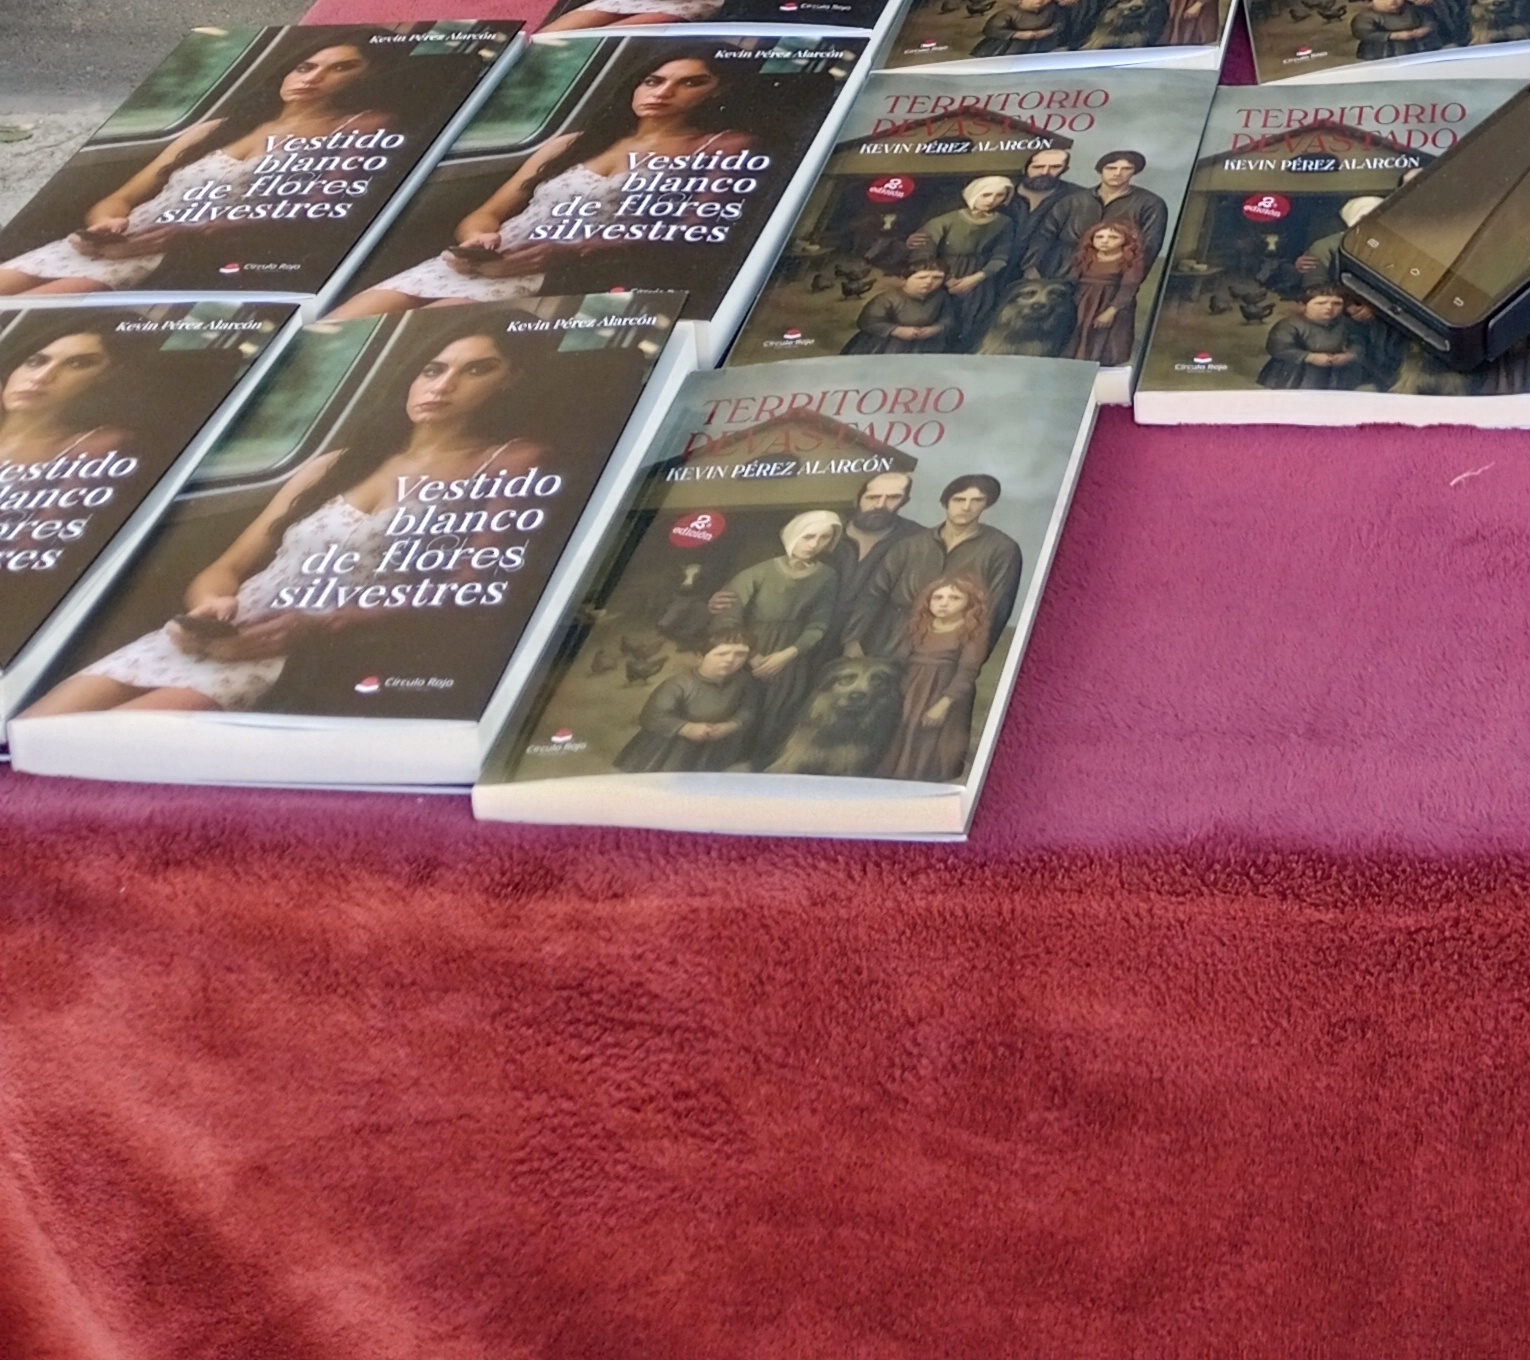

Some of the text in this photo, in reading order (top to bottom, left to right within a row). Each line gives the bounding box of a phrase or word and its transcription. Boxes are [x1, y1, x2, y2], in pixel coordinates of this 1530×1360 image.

[368, 33, 407, 45] Kevin
[715, 47, 753, 60] Kevin
[884, 88, 1110, 115] TERRITORIO
[870, 113, 1096, 138] DEVASTADO
[1237, 102, 1468, 130] TERRITORIO
[264, 129, 405, 153] Vestido
[859, 137, 1053, 155] KEVIN PÉREZ ALARCÓN
[1231, 128, 1459, 154] DEVASTADO
[253, 151, 389, 175] blanco
[625, 149, 770, 173] Vestido
[1224, 155, 1420, 171] KEVIN PÉREZ ALARCÓN
[182, 175, 369, 202] de flores
[621, 171, 757, 194] blanco
[155, 198, 353, 225] silvestres
[551, 192, 743, 219] de flores
[528, 217, 730, 244] silvestres
[115, 319, 160, 333] Kevin
[507, 314, 658, 333] Kevin Pérez Alarcón
[704, 386, 964, 426] TERRITORIO
[684, 419, 945, 459] DEVASTADO
[0, 450, 139, 481] estido
[666, 454, 894, 481] KEVIN PÉREZ ALARCÓN
[394, 468, 563, 504] Vestido
[385, 504, 545, 538] blanco
[300, 538, 526, 575] de flores
[271, 575, 508, 610] silvestres
